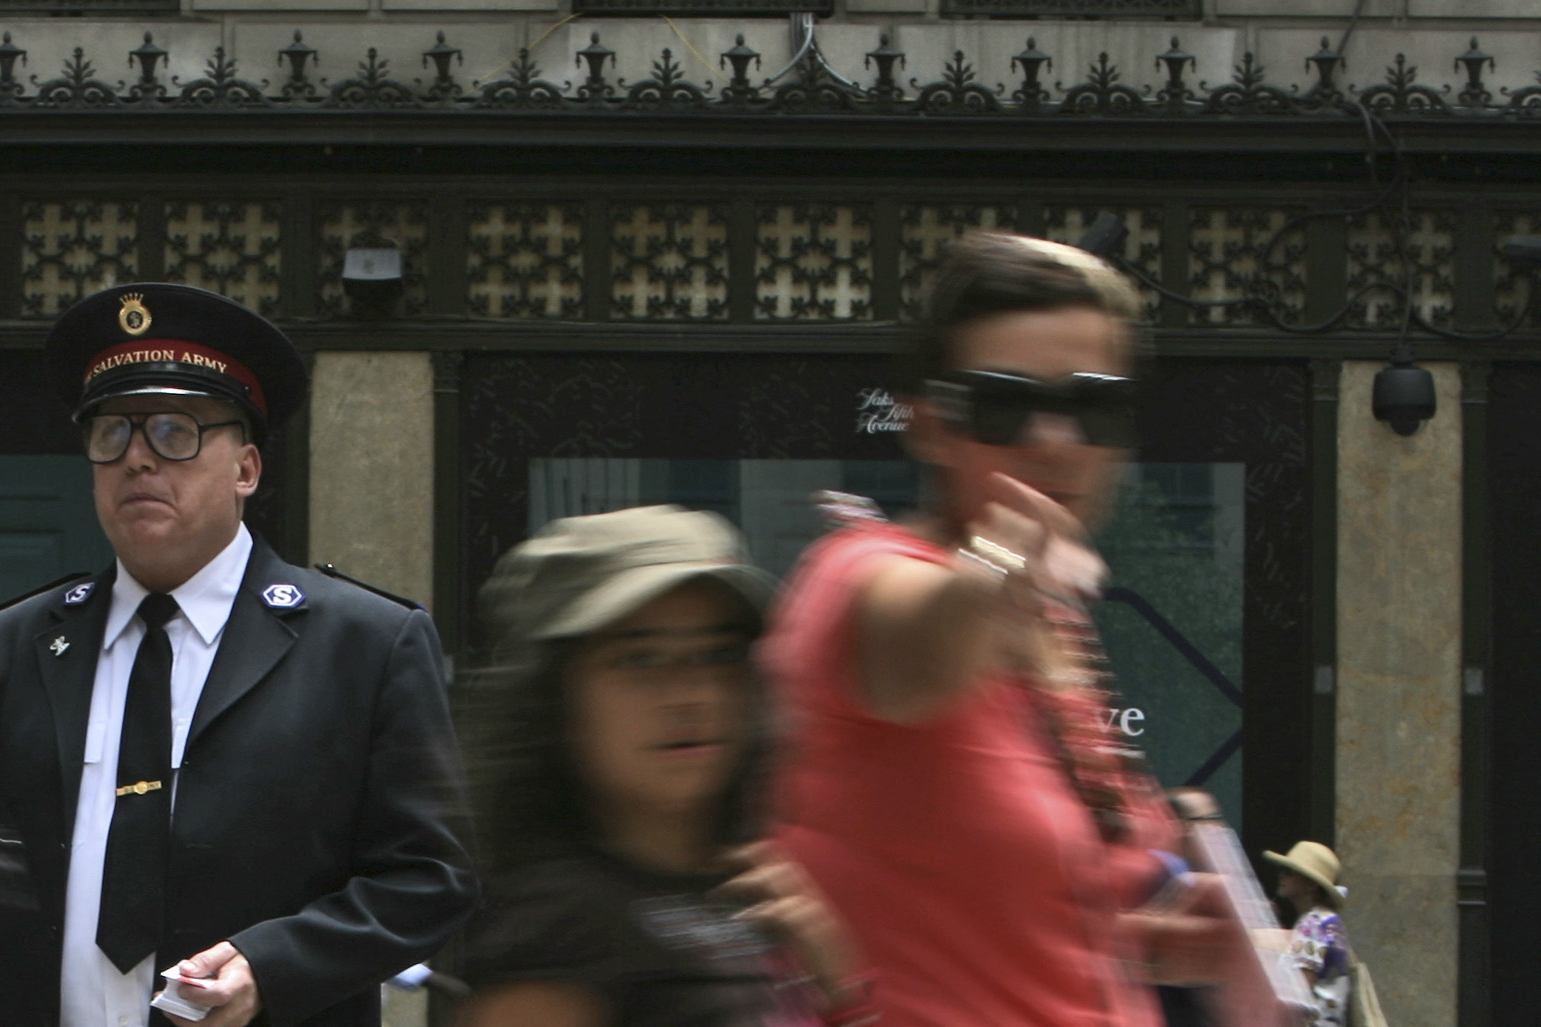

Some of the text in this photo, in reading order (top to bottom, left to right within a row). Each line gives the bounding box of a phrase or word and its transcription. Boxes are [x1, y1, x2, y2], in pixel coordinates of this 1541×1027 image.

[93, 350, 227, 376] SALVATION ARMY
[857, 388, 894, 410] Saks
[272, 587, 293, 604] S
